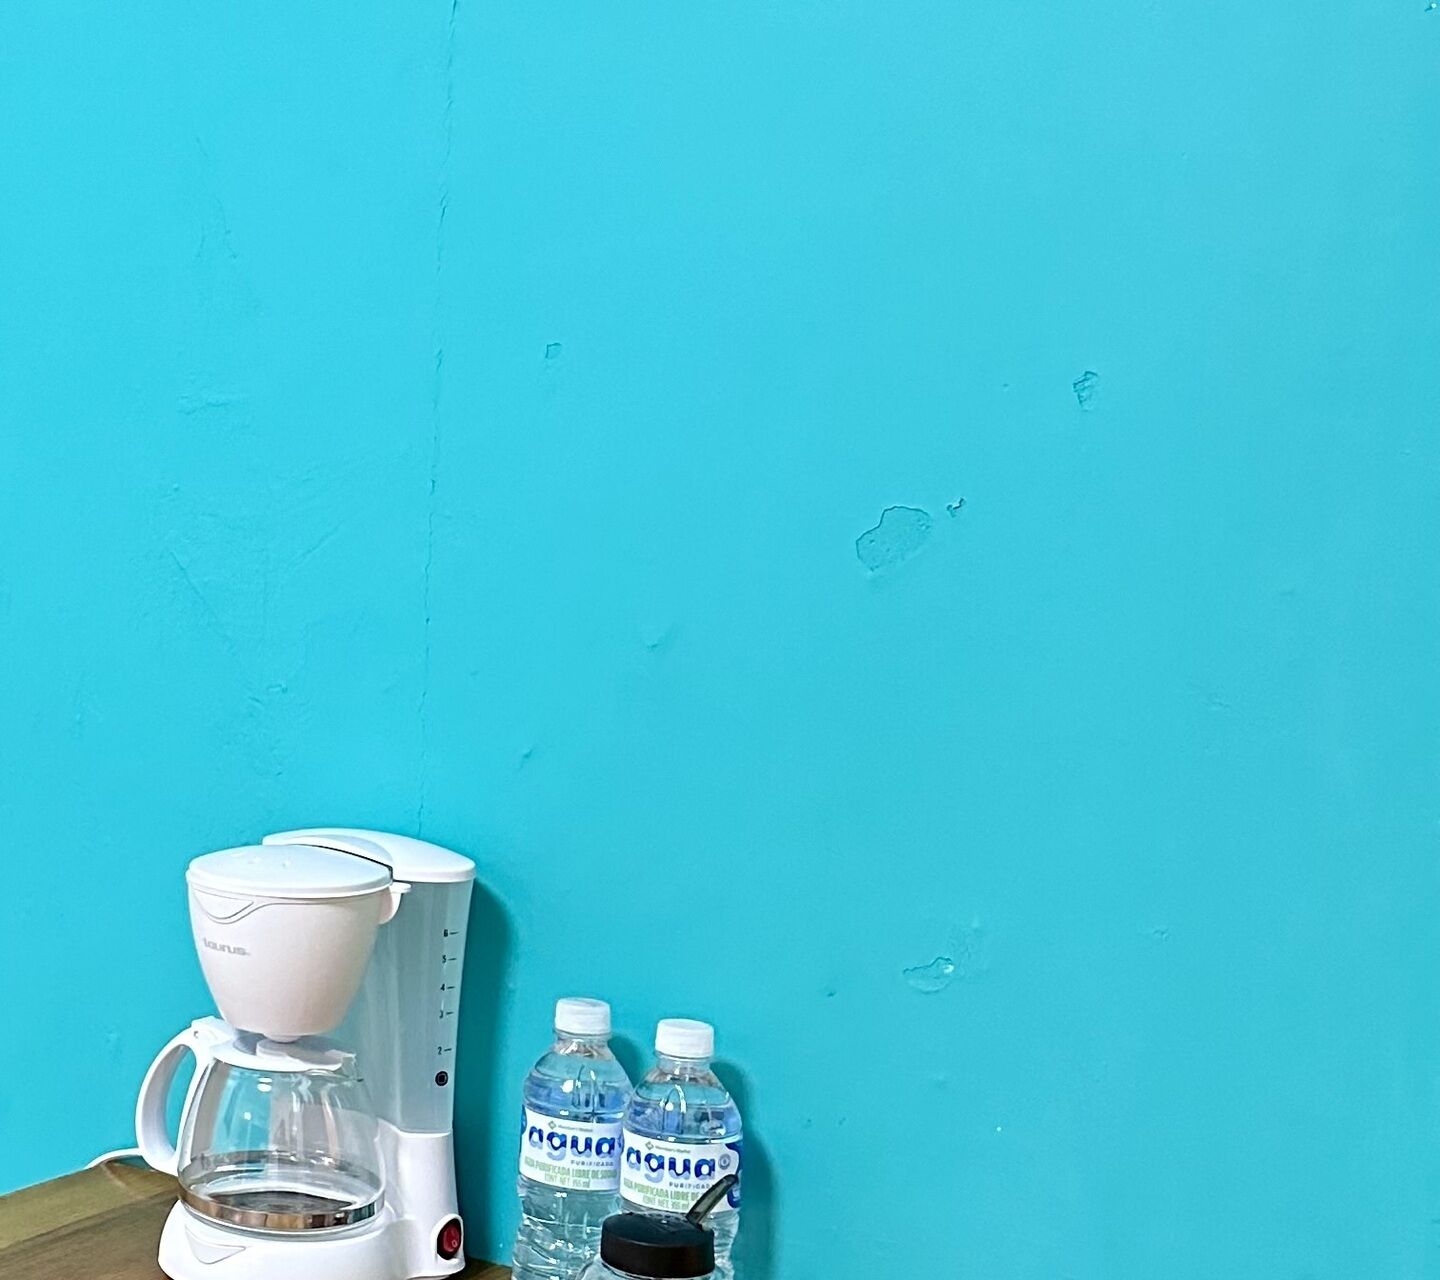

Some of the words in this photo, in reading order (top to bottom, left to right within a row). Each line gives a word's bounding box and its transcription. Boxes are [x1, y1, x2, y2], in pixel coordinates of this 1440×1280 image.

[203, 937, 247, 956] taurus
[440, 983, 446, 992] 4
[437, 1046, 442, 1056] 2
[529, 1125, 616, 1161] agua
[626, 1146, 716, 1183] agua
[669, 1181, 712, 1190] PURIFICAD
